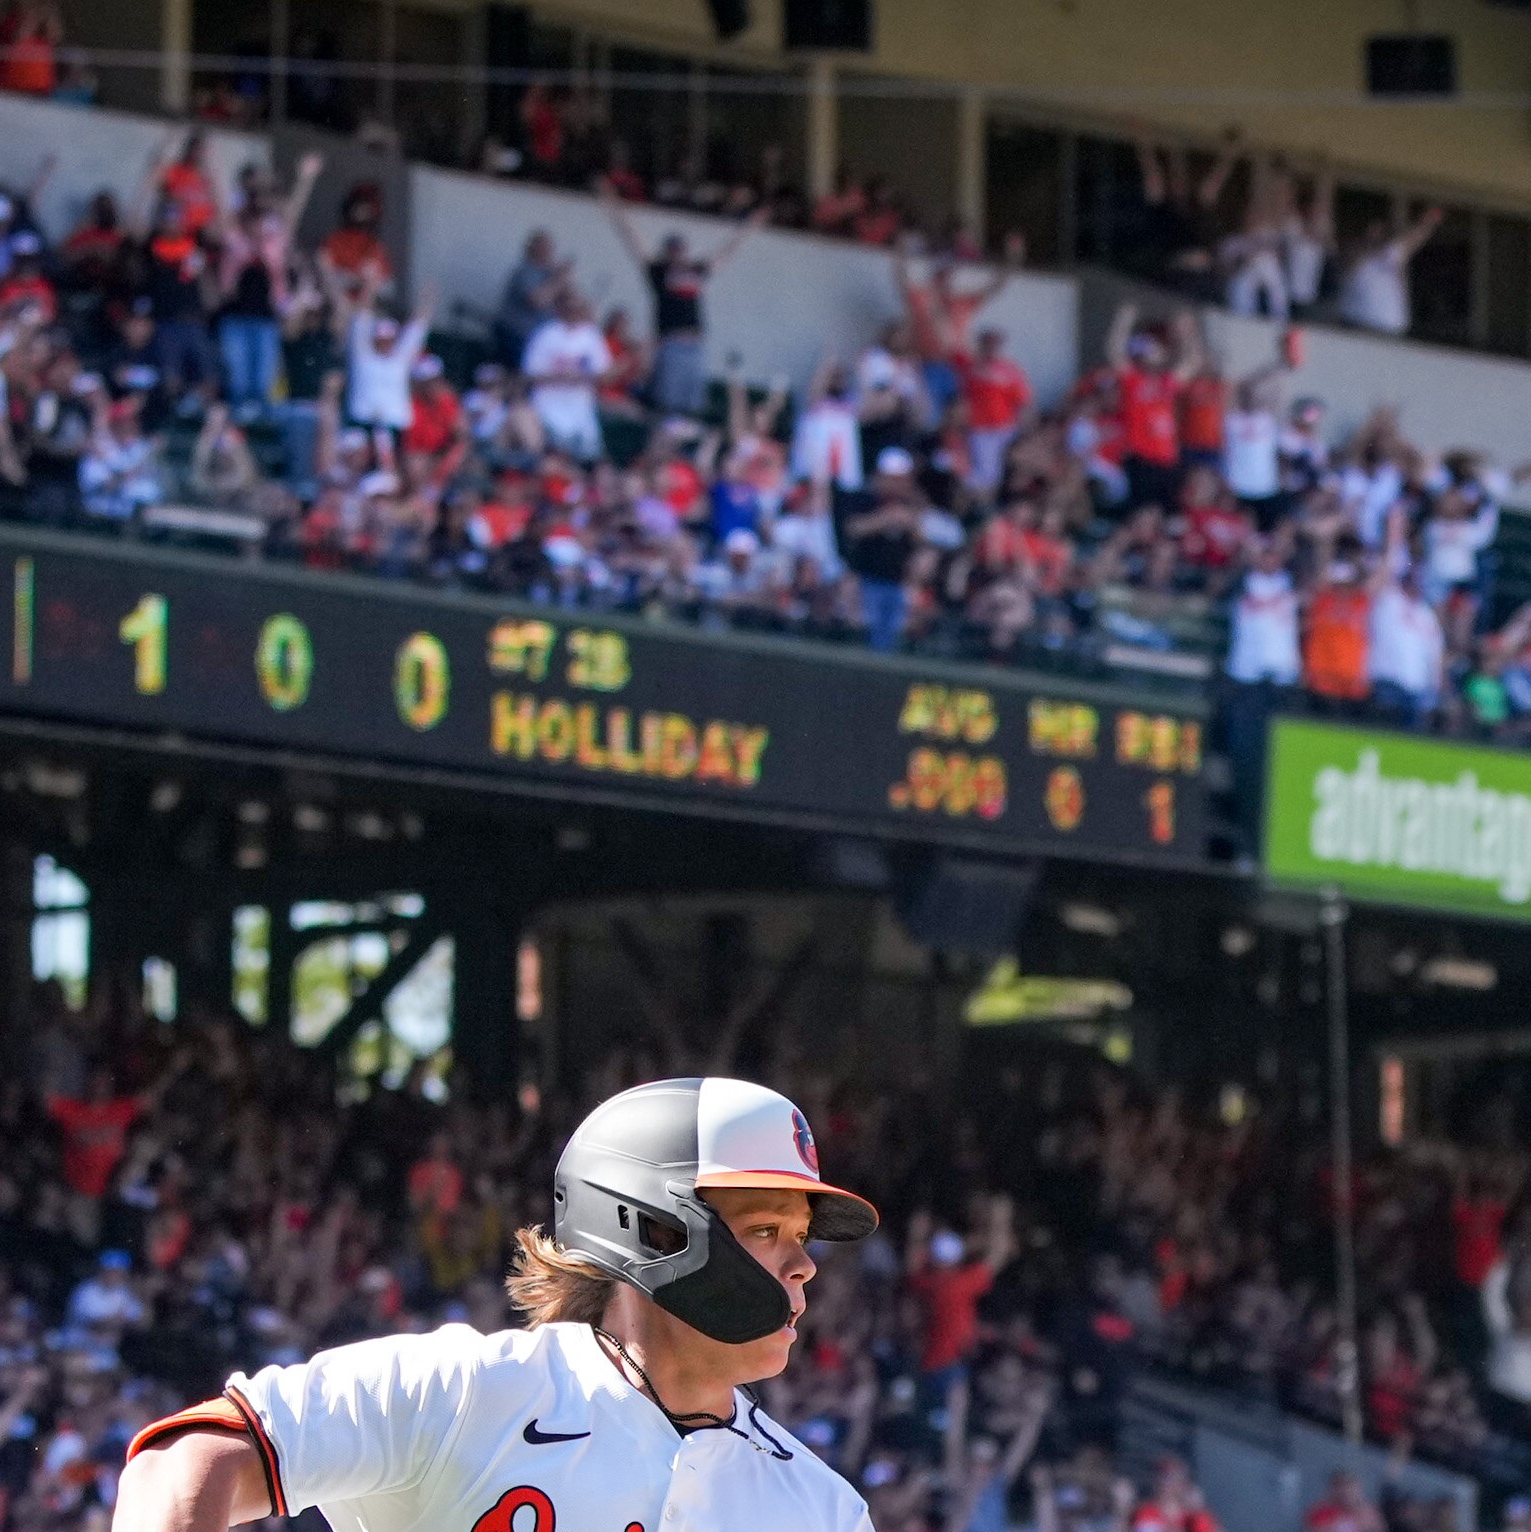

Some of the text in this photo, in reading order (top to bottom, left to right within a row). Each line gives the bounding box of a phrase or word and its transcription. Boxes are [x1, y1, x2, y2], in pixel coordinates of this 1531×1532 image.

[119, 592, 450, 732] 1 0 0
[490, 692, 768, 787] HOLLIDAY
[898, 683, 999, 744] AVG
[1116, 712, 1203, 777] RBI
[1143, 780, 1176, 845] 1
